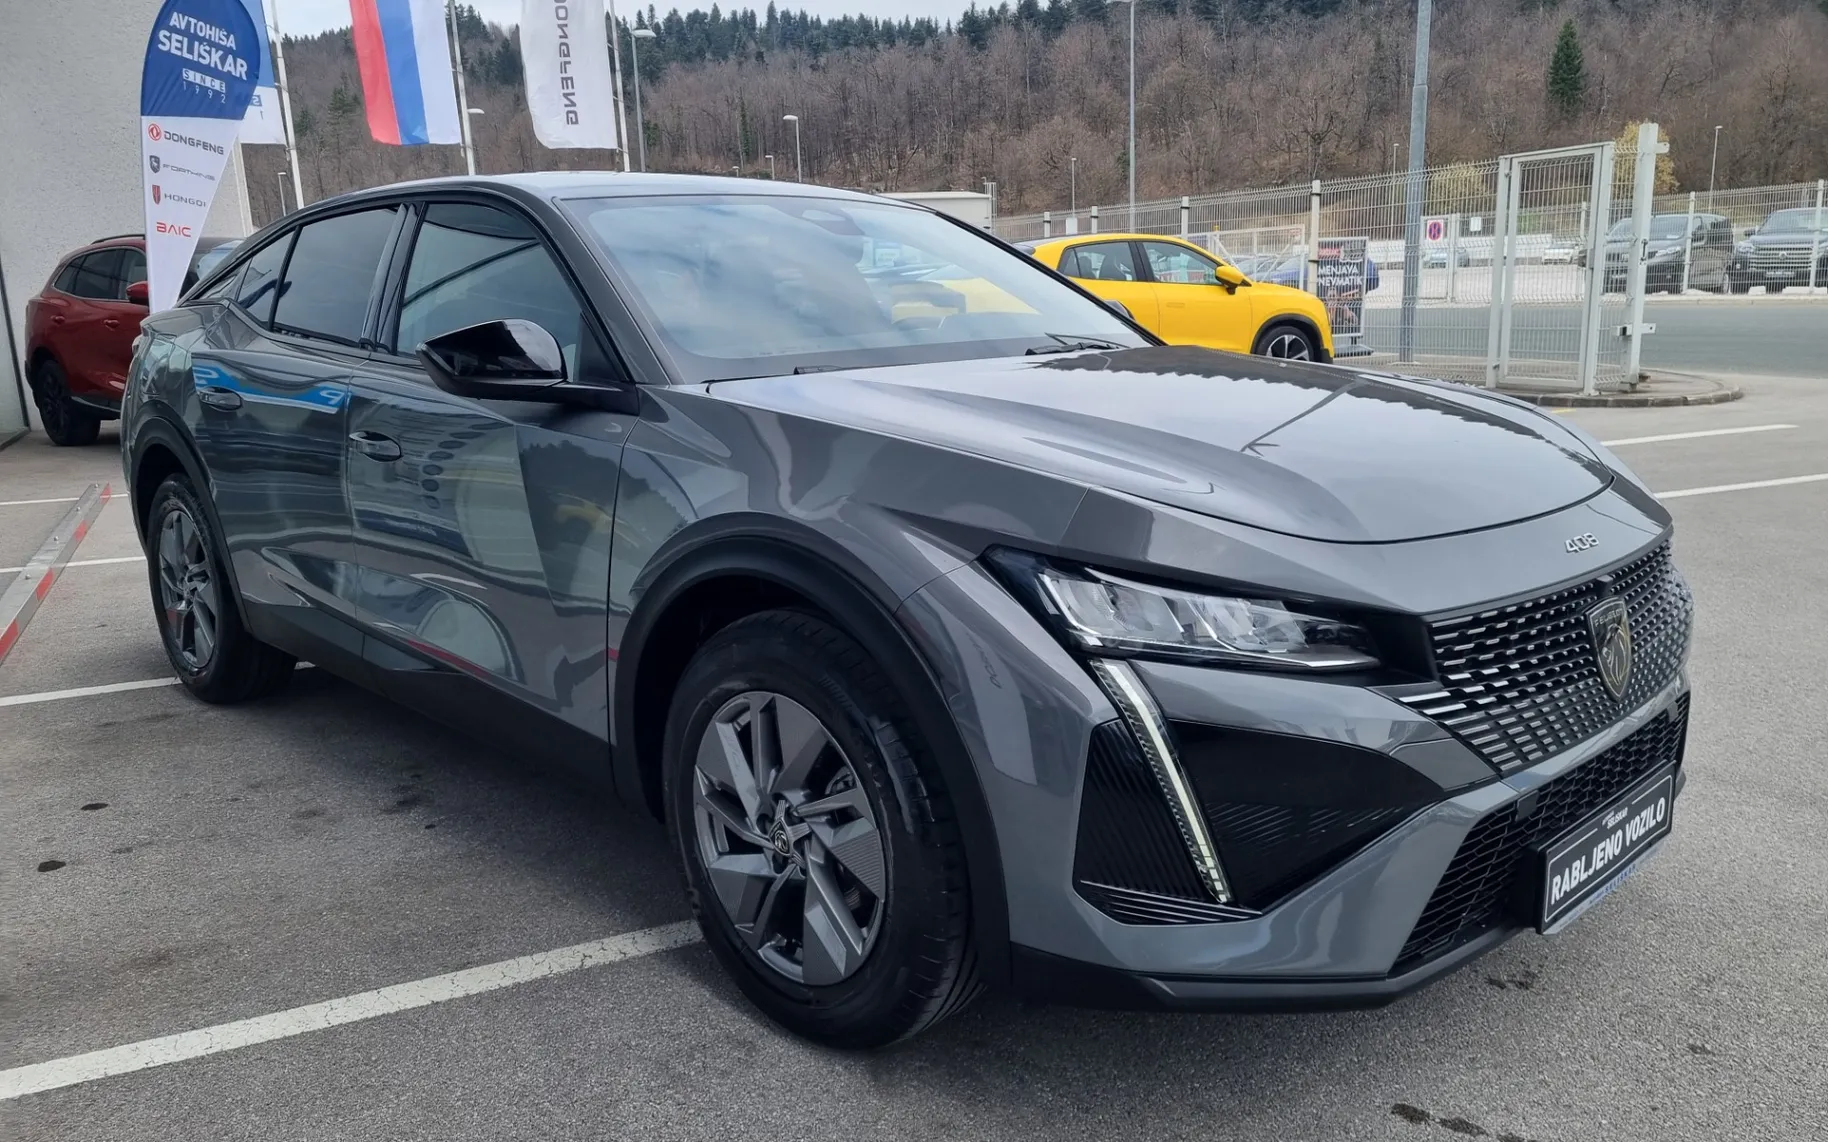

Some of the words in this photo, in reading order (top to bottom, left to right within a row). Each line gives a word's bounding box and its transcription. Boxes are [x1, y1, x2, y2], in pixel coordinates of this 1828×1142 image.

[169, 11, 237, 50] AVTOHIŠA
[158, 29, 248, 81] SELIŠKAR
[183, 68, 226, 92] SINCE
[183, 81, 226, 104] 1992
[163, 130, 224, 155] DONGFENG
[156, 221, 192, 238] BAIC
[1565, 532, 1600, 553] 408
[1551, 829, 1623, 905] RABLJENO
[1626, 797, 1666, 847] VOZILO
